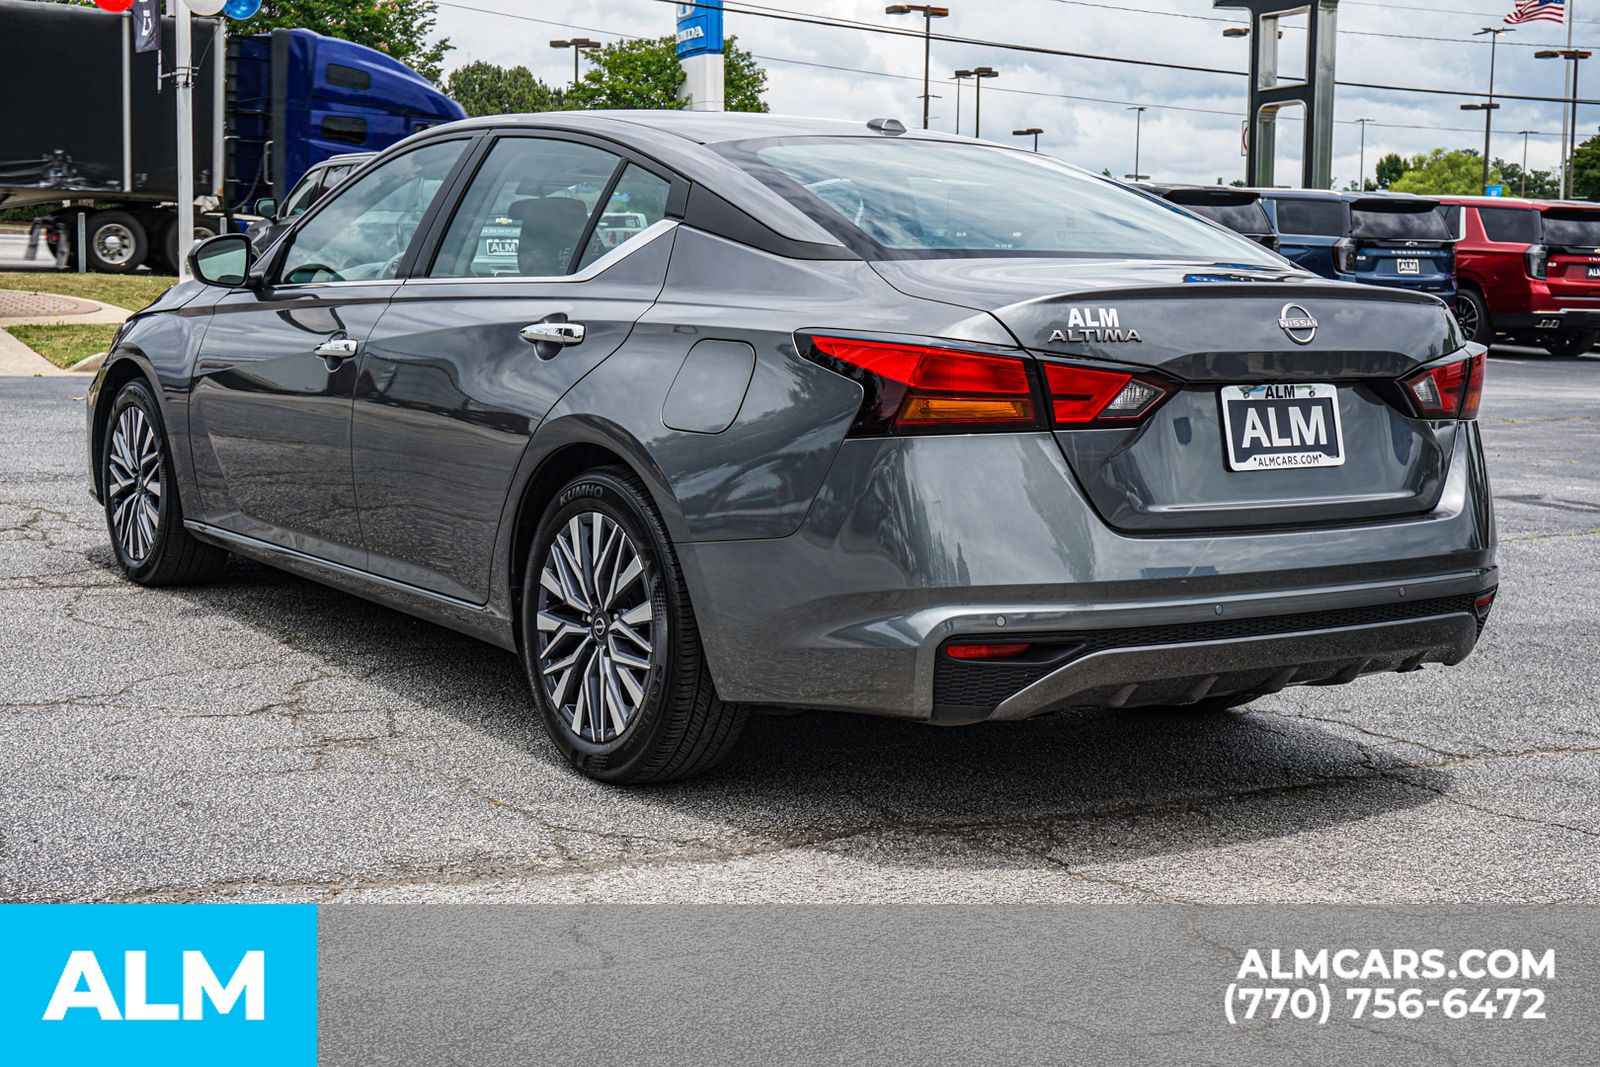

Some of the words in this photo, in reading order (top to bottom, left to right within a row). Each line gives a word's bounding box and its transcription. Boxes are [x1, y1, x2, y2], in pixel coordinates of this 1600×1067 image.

[490, 243, 516, 252] ALM
[1400, 263, 1417, 271] ALM
[1067, 308, 1120, 328] ALM
[1280, 319, 1318, 327] NISSAN
[1048, 329, 1142, 343] ALTIMA
[1265, 385, 1295, 399] ALM
[1241, 405, 1328, 448] ALM
[1258, 455, 1319, 467] ALMCARS.COM
[559, 485, 603, 507] KUMHO
